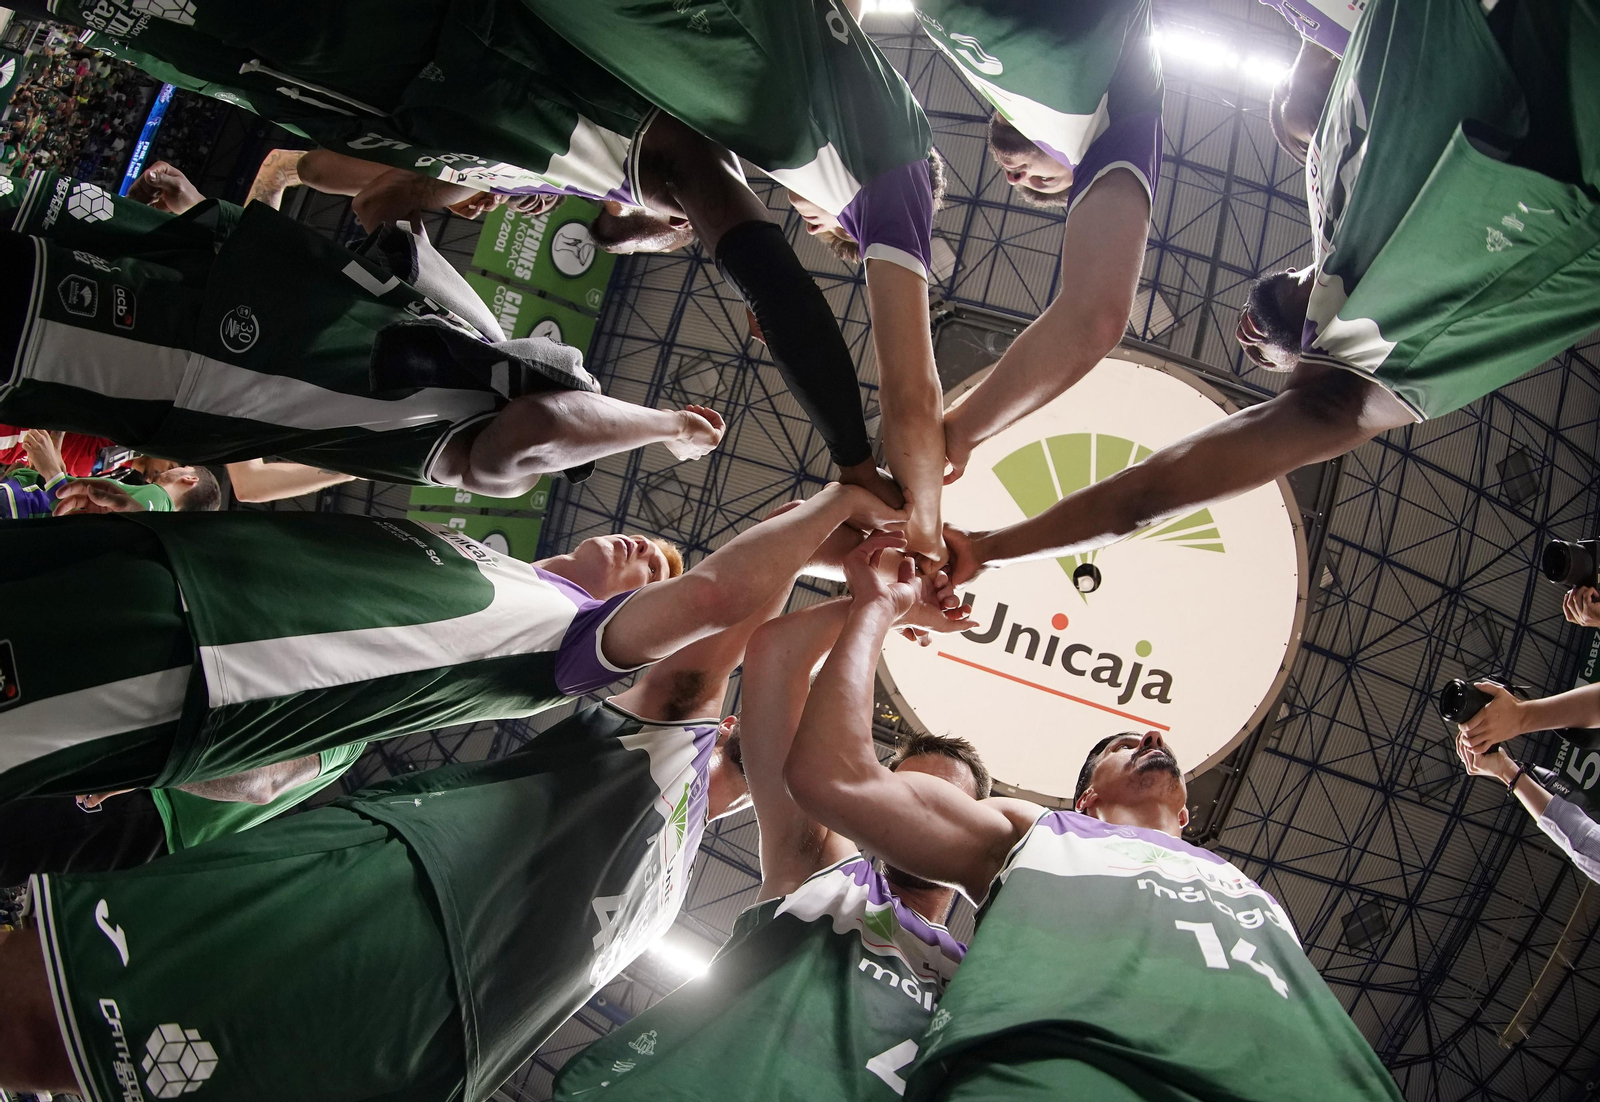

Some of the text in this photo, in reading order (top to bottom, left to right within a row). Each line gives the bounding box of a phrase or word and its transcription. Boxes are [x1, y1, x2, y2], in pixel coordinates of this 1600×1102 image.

[506, 221, 529, 271] KORAC
[514, 211, 551, 281] MPEONES
[116, 288, 128, 316] acb
[493, 285, 507, 316] COP
[238, 321, 254, 343] 30
[960, 591, 1174, 706] Unicaja
[1584, 631, 1600, 678] CABEZ
[1552, 739, 1571, 777] BERN
[1566, 746, 1600, 790] 5
[1552, 781, 1570, 795] SONY
[858, 957, 939, 1013] mál
[98, 998, 145, 1102] CATHEDR
[112, 1060, 131, 1102] SOFT
